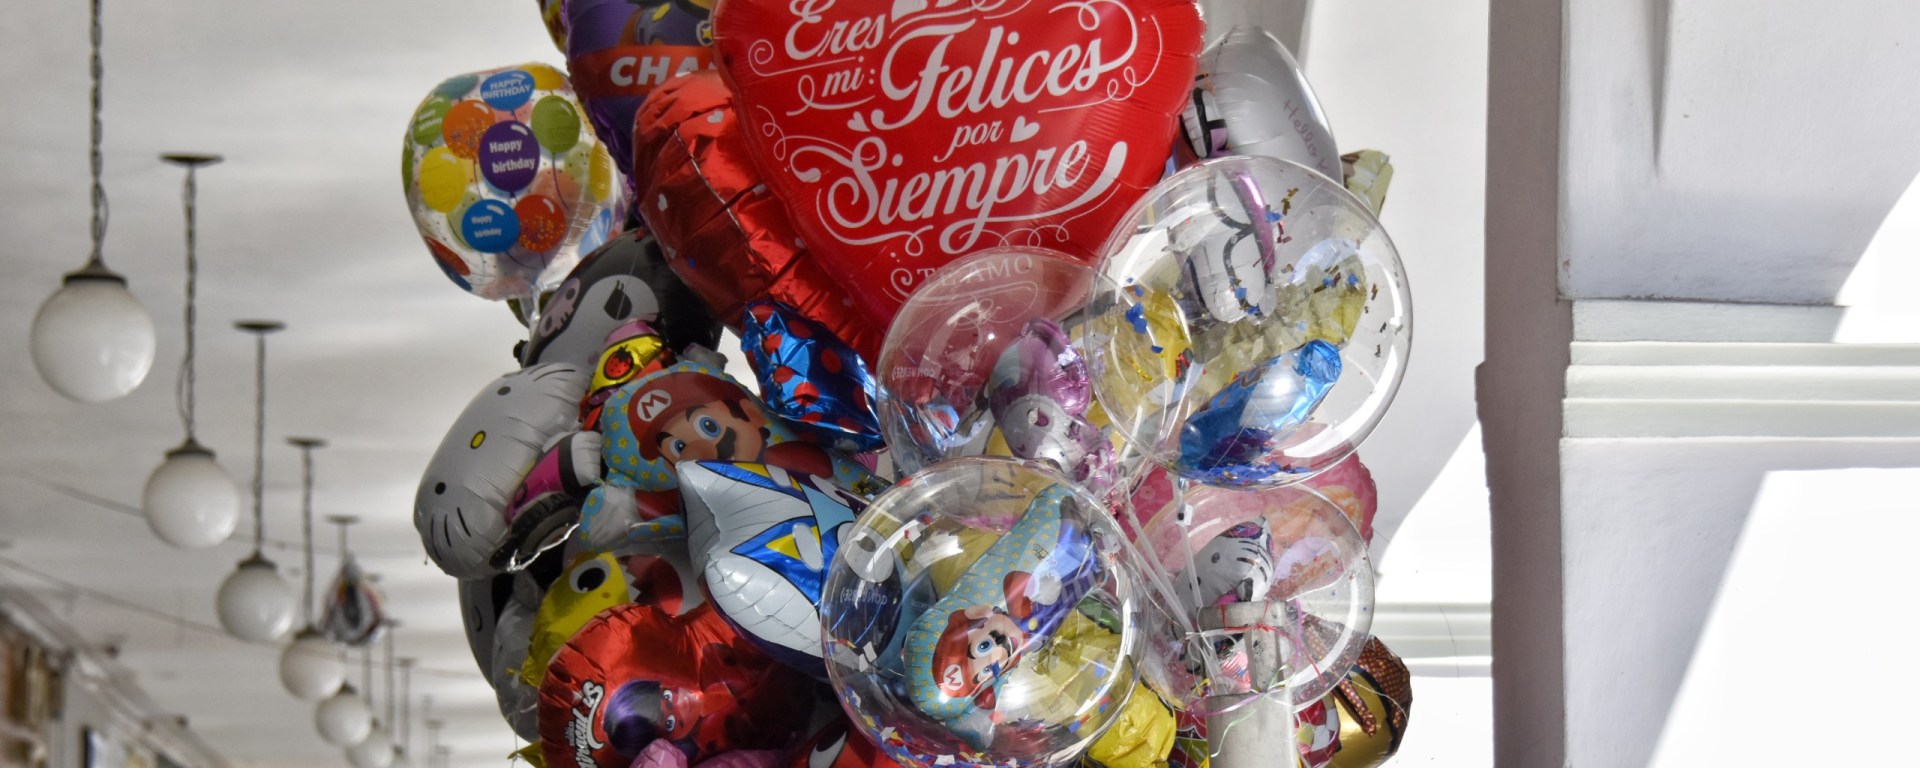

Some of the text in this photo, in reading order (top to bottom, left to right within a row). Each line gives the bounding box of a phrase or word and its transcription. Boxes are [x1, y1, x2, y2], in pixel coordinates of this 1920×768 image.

[784, 0, 886, 60] Eres
[610, 56, 718, 87] CHA
[871, 2, 1137, 130] Felices
[481, 84, 532, 100] BIRTHDAY
[489, 76, 524, 92] HAPPY
[933, 120, 1003, 162] por
[1283, 99, 1317, 157] Hello
[489, 139, 523, 154] Happy
[492, 157, 536, 174] birthday
[790, 136, 1128, 254] Siempre
[965, 254, 1033, 283] AMO
